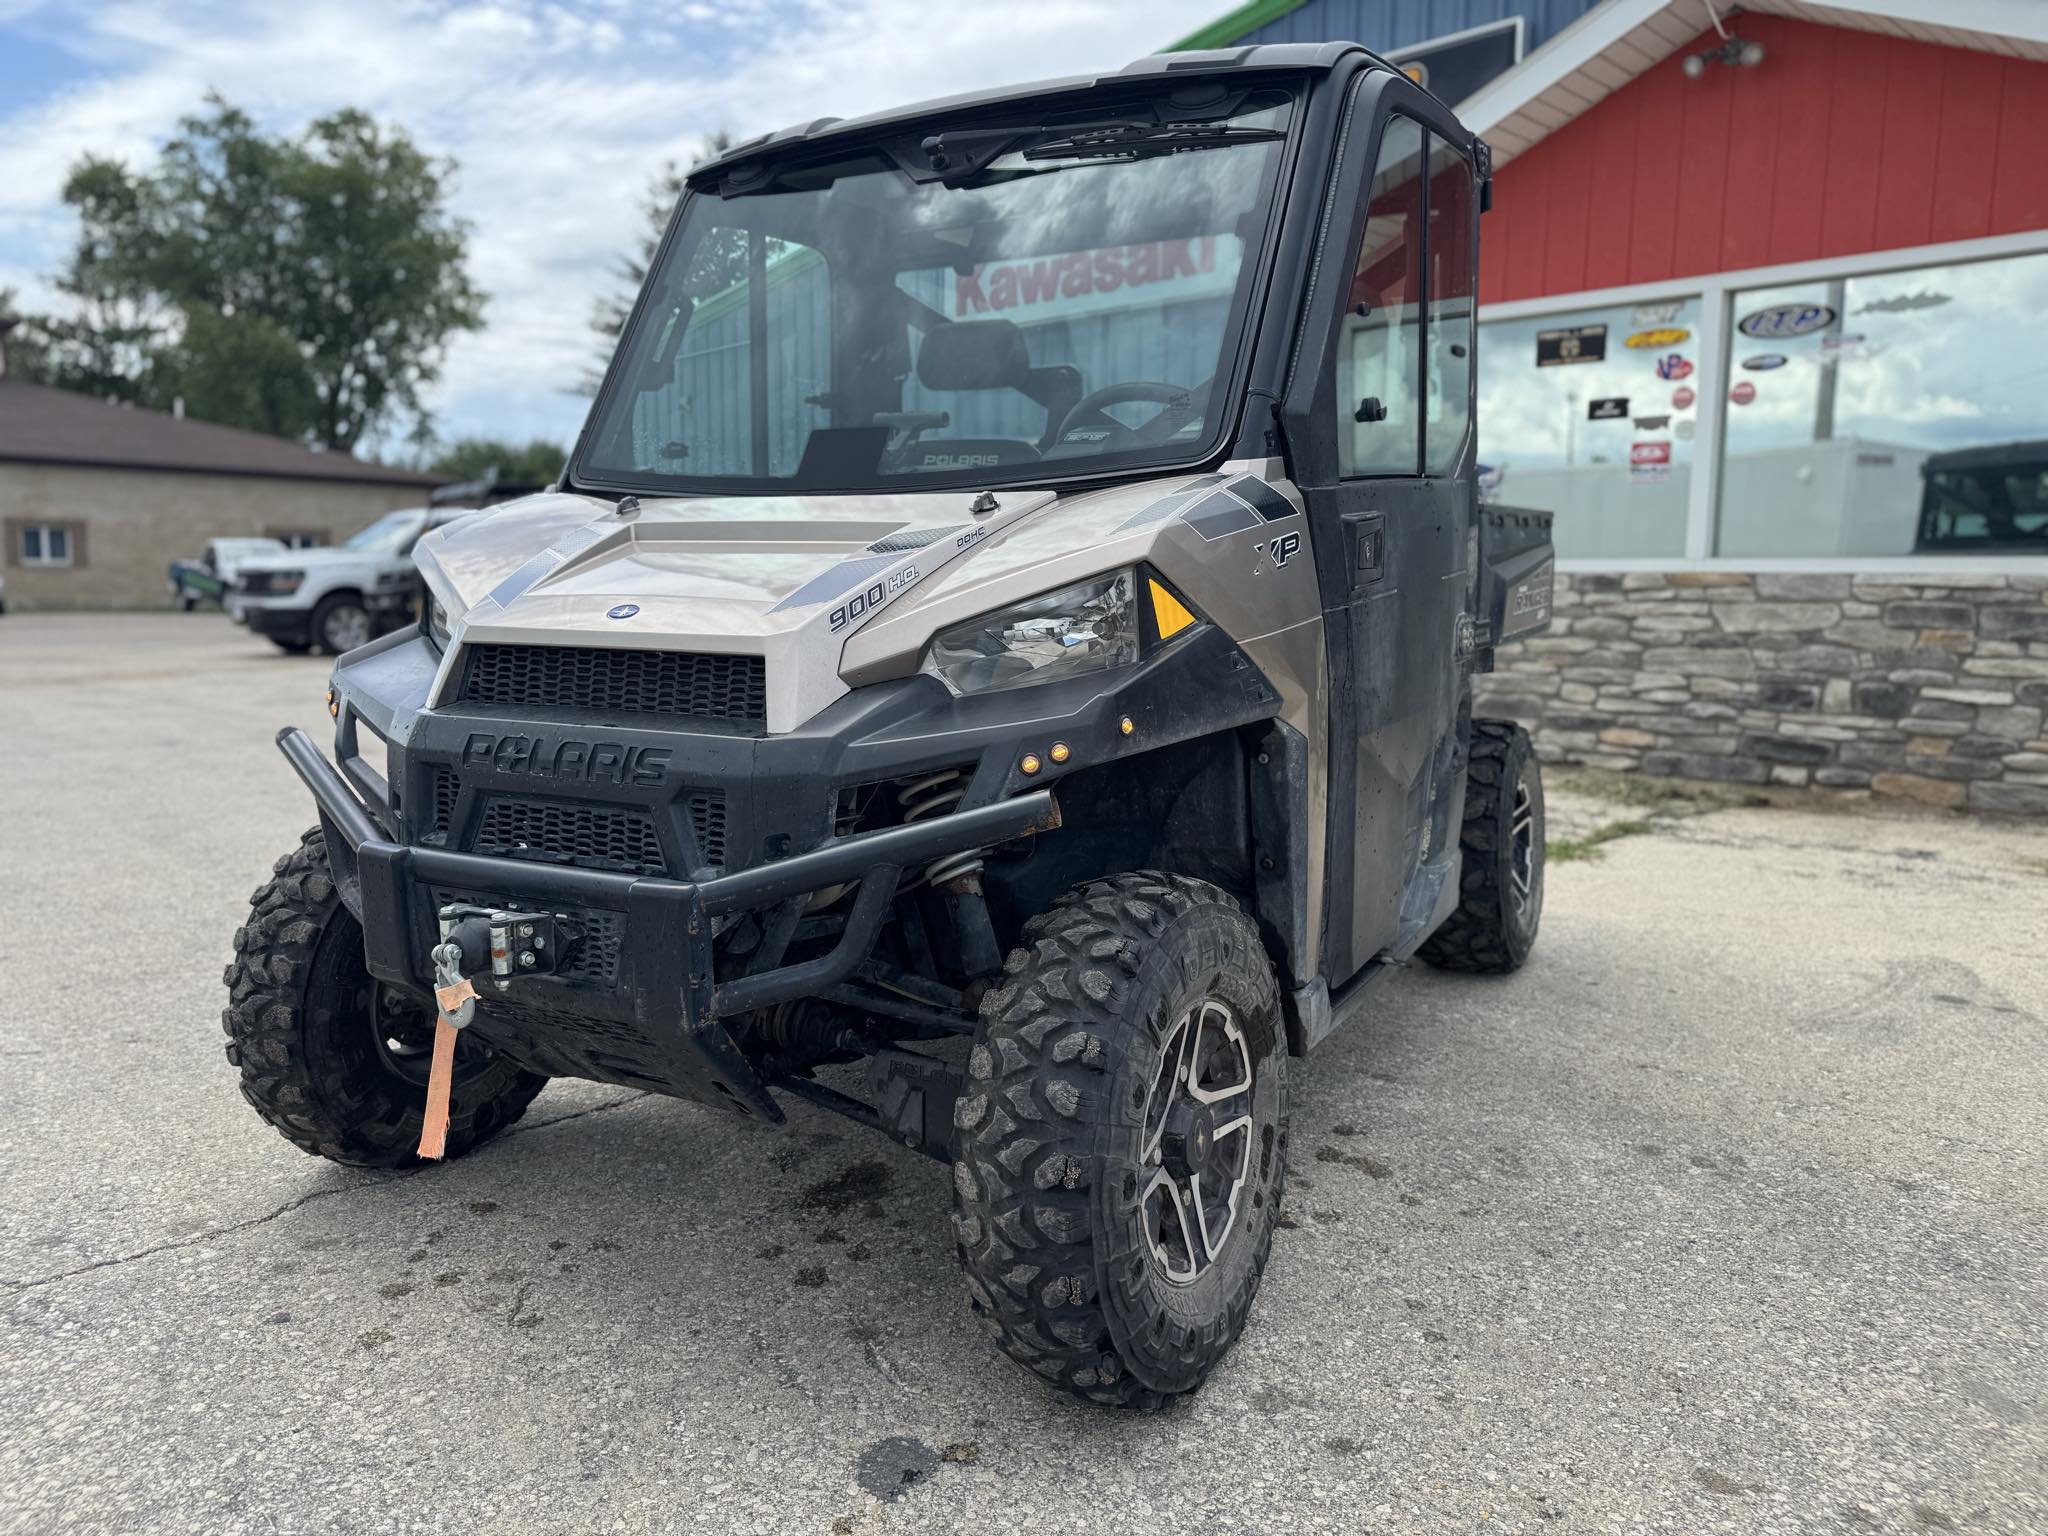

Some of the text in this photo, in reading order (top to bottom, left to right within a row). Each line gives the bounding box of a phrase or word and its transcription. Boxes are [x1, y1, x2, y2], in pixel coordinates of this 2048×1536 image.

[955, 236, 1217, 316] Kawasaki
[1750, 307, 1822, 332] ITP
[923, 454, 1000, 466] POLARIS
[956, 526, 986, 548] DOHC
[828, 564, 920, 633] 900 H.O.
[462, 733, 674, 788] POLARIS
